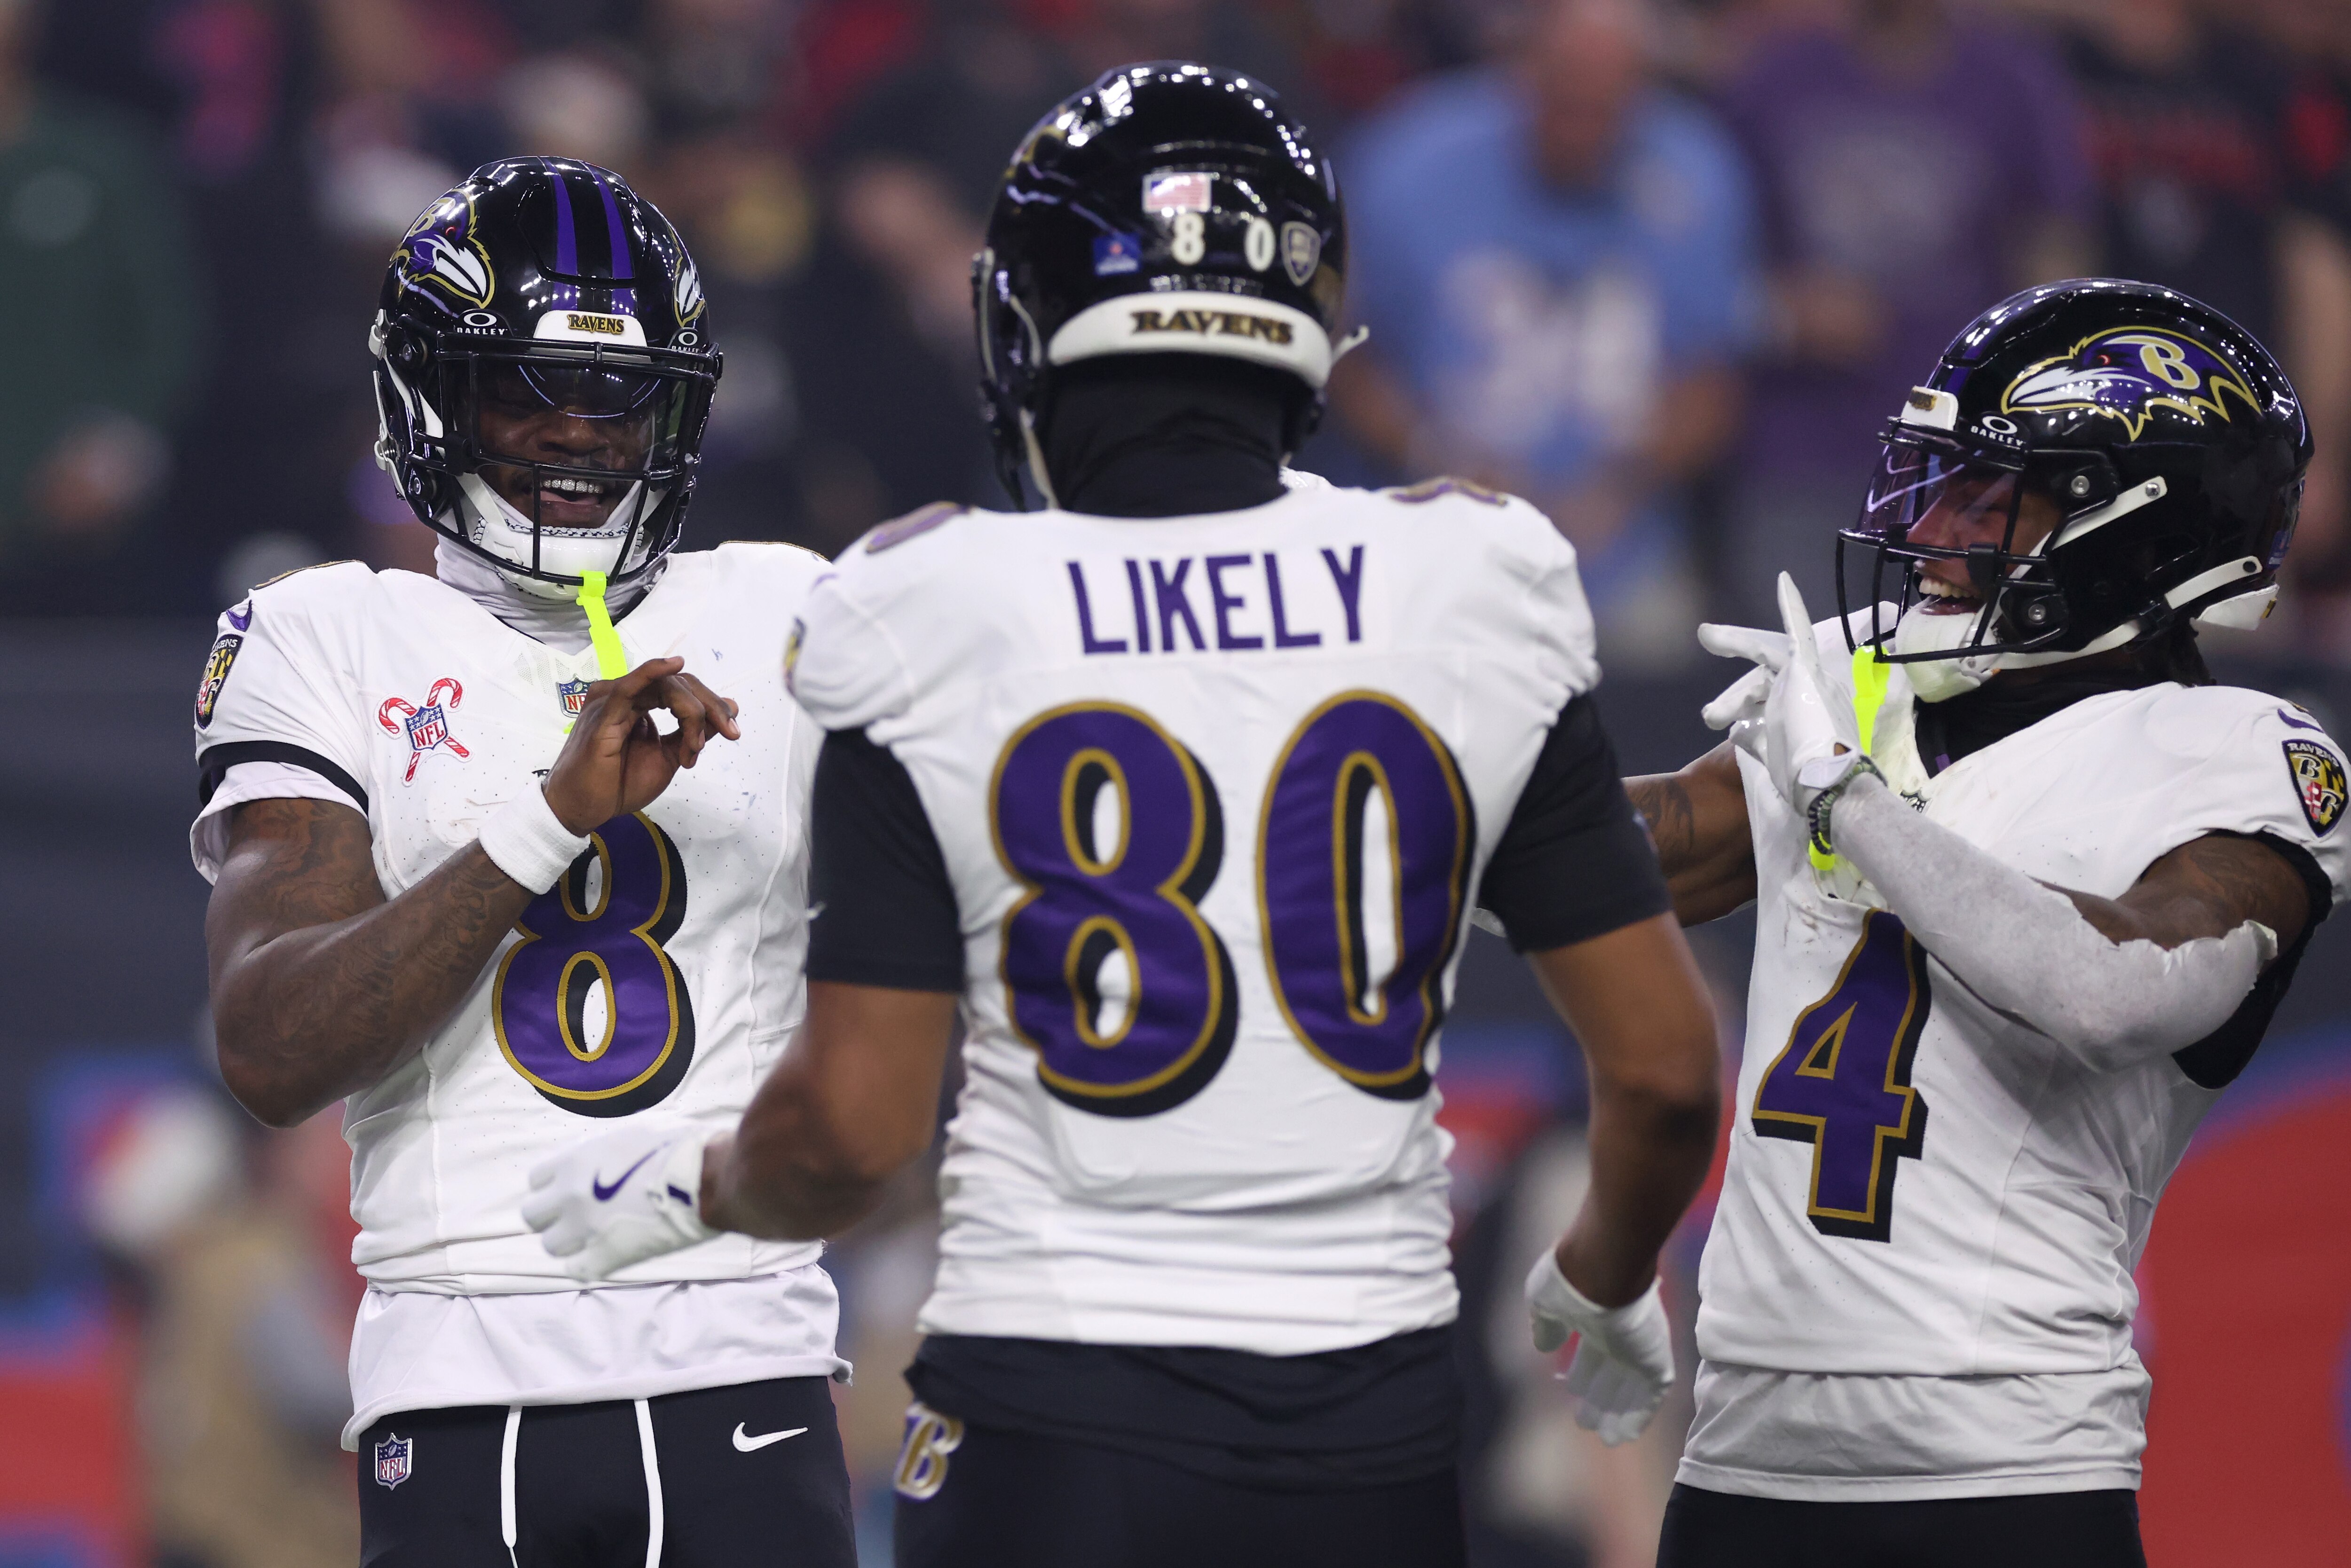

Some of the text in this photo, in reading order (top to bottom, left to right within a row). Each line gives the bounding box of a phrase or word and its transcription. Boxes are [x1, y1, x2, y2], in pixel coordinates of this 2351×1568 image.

[567, 314, 624, 335] RAVENS
[1130, 309, 1293, 344] RAVENS
[2102, 335, 2201, 390] B
[1971, 425, 2023, 446] OAKLEY
[1066, 545, 1365, 654] LIKELY
[566, 694, 587, 710] NF
[413, 722, 445, 748] NFL
[988, 688, 1477, 1119] 80
[492, 810, 695, 1118] 8
[1751, 907, 1932, 1243] 4
[380, 1458, 405, 1479] NFL
[894, 1401, 965, 1500] B
